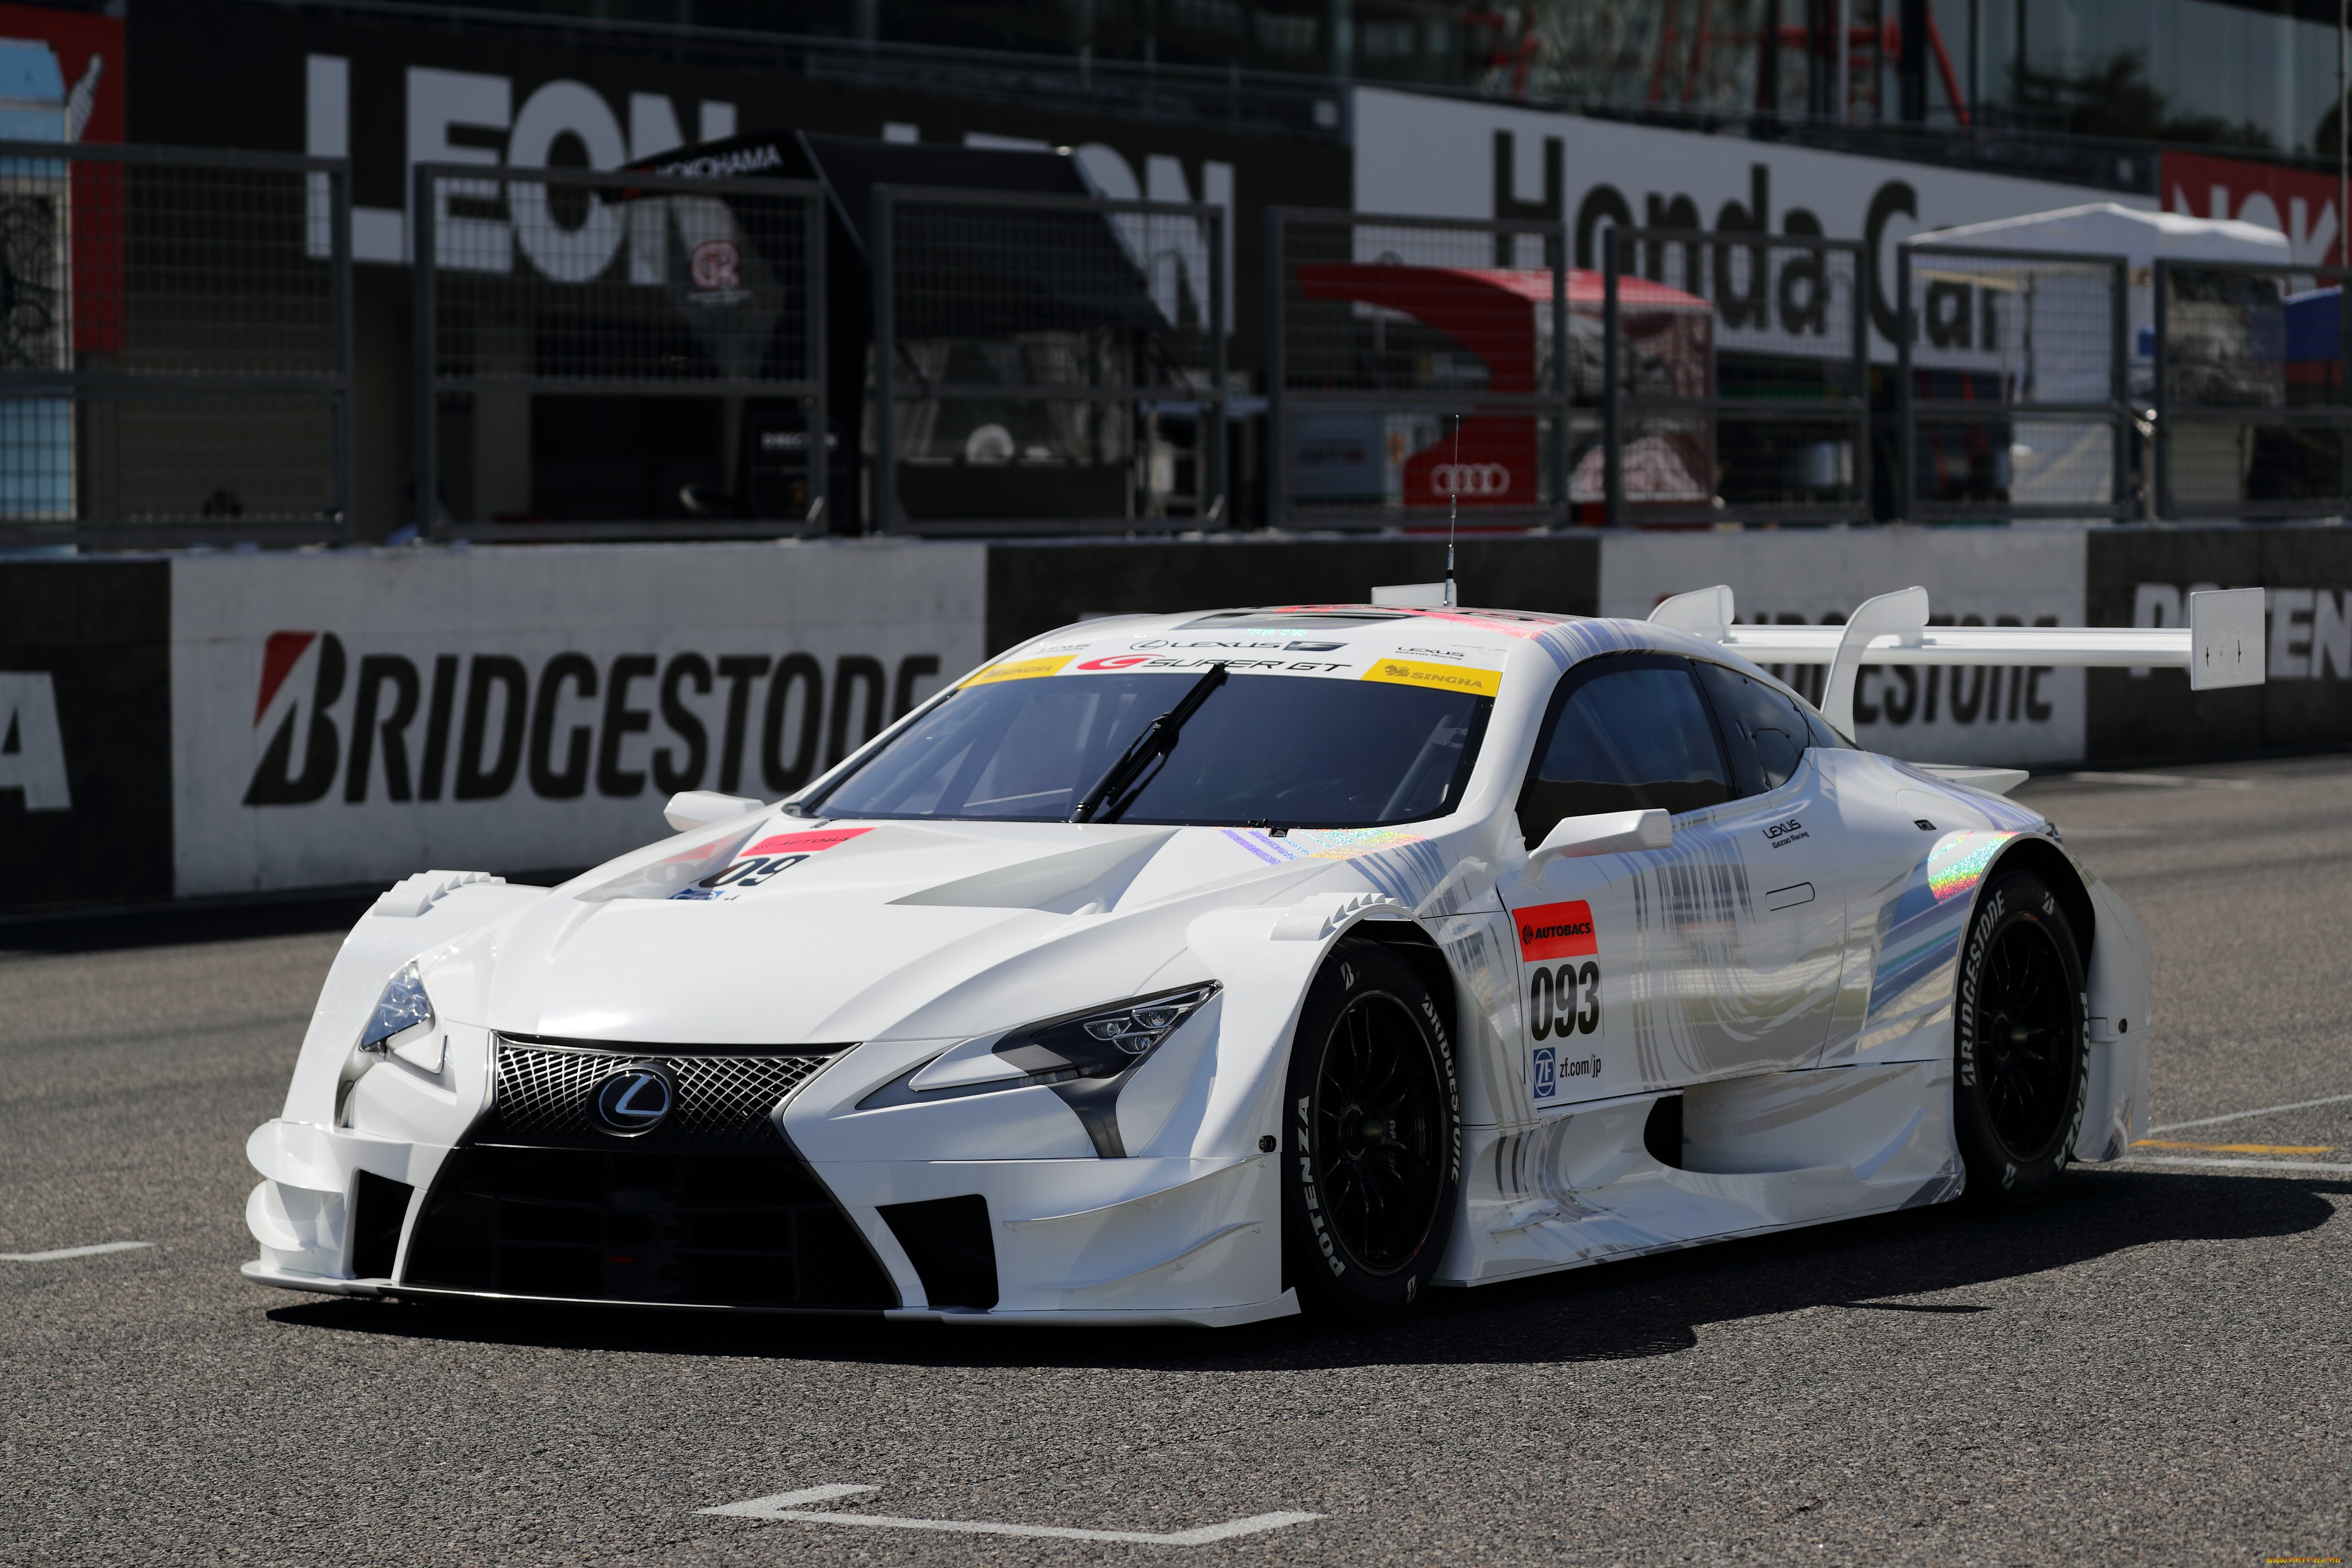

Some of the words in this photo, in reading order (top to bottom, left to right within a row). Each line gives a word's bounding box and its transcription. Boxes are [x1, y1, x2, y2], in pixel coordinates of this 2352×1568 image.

[1495, 130, 1828, 335] Honda
[1398, 646, 1465, 657] LEXUS
[1430, 653, 1462, 661] Racing
[1142, 659, 1287, 669] SUPER
[1285, 662, 1353, 672] GT
[1410, 671, 1483, 688] SINGHA
[1762, 819, 1802, 839] LEXUS
[1790, 831, 1809, 841] Racing
[1534, 922, 1592, 940] AUTOBACS
[1960, 889, 2005, 1086] BRIDGESTONE
[1531, 961, 1600, 1042] 093
[1535, 1058, 1555, 1087] ZF
[1560, 1053, 1601, 1079] zf.com/jp
[1421, 992, 1461, 1188] BRIDGESTONE
[1297, 1095, 1347, 1278] POTENZA
